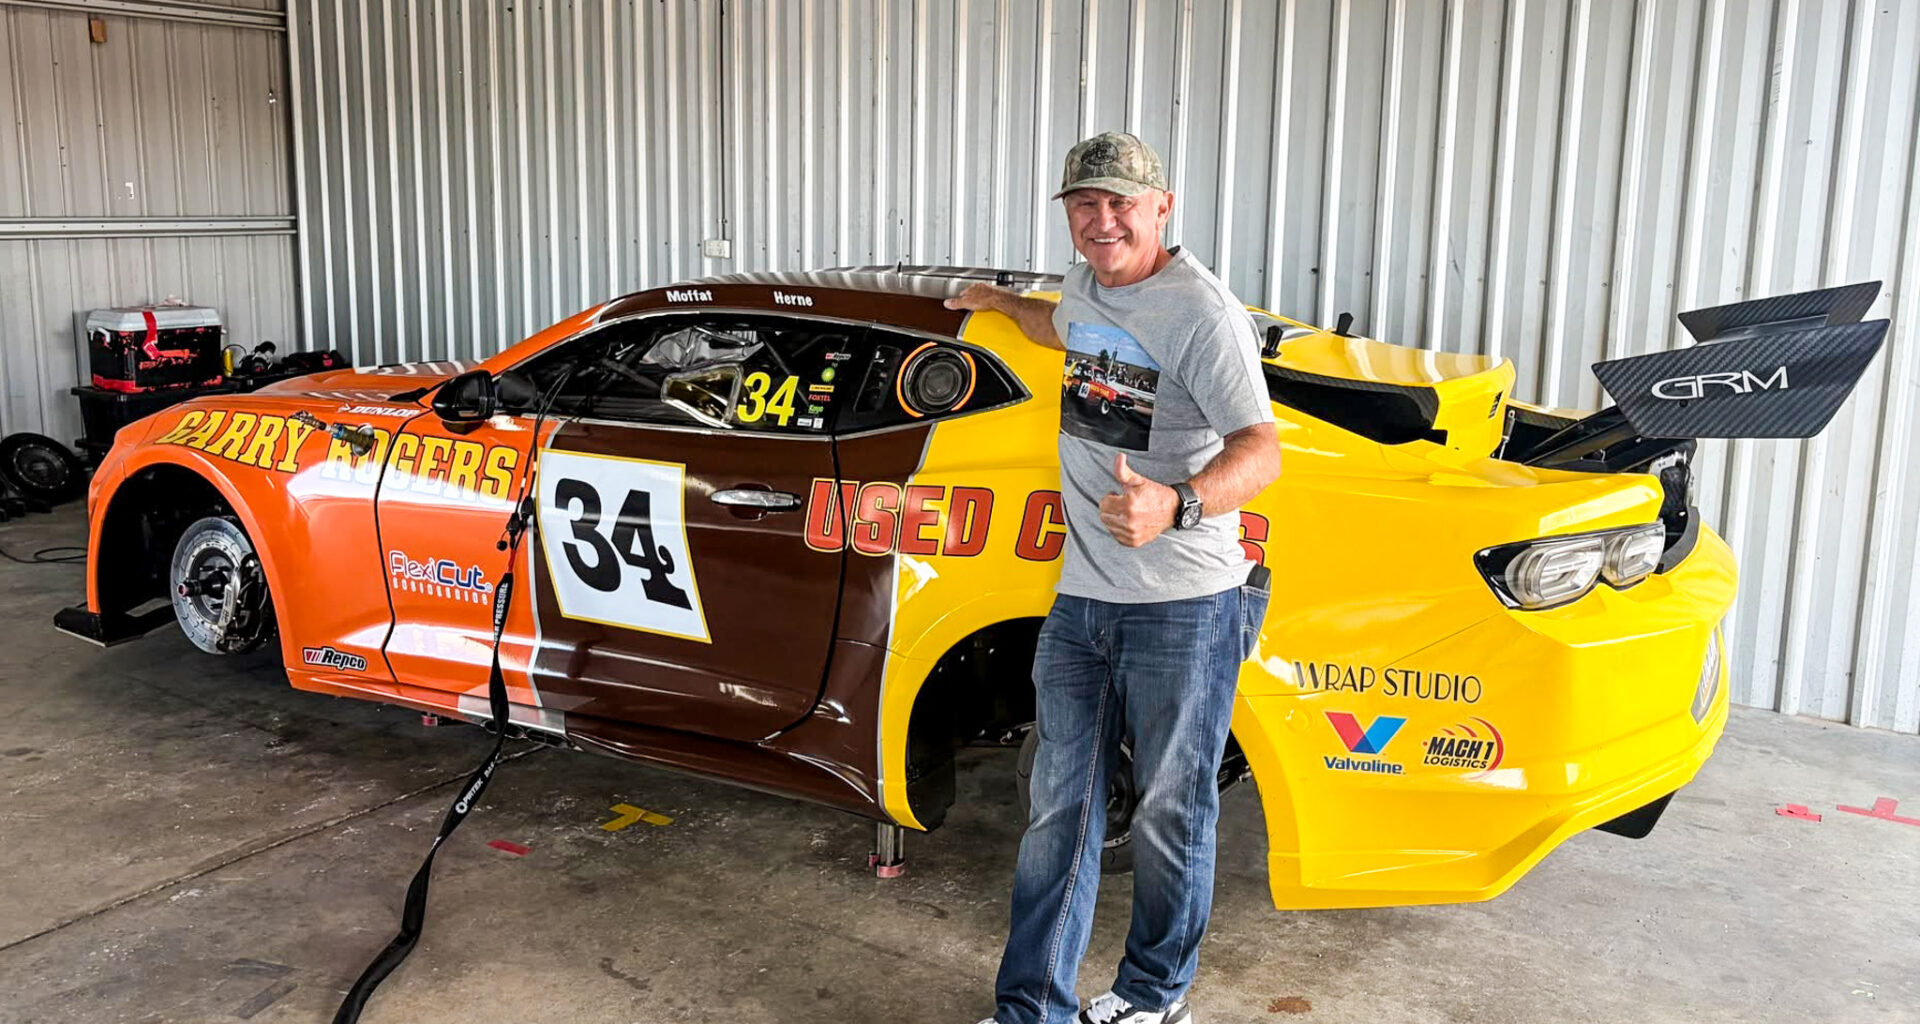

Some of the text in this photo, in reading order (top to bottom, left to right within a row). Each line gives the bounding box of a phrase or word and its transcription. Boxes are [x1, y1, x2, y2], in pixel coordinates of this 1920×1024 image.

[666, 290, 814, 306] Moffat Herne
[736, 371, 799, 426] 34
[1651, 366, 1789, 399] GRM
[348, 405, 420, 418] DUNLOP
[154, 410, 519, 505] GARRY ROGERS
[804, 477, 1270, 567] USED CS
[555, 478, 693, 611] 34
[389, 550, 487, 592] FlexiCut
[494, 583, 509, 625] PRESSURE
[321, 649, 365, 669] Repco
[1294, 661, 1482, 703] WRAP STUDIO
[1324, 756, 1403, 774] Valvoline
[1423, 755, 1488, 769] LOGISTICS
[1427, 737, 1495, 760] MACH 1
